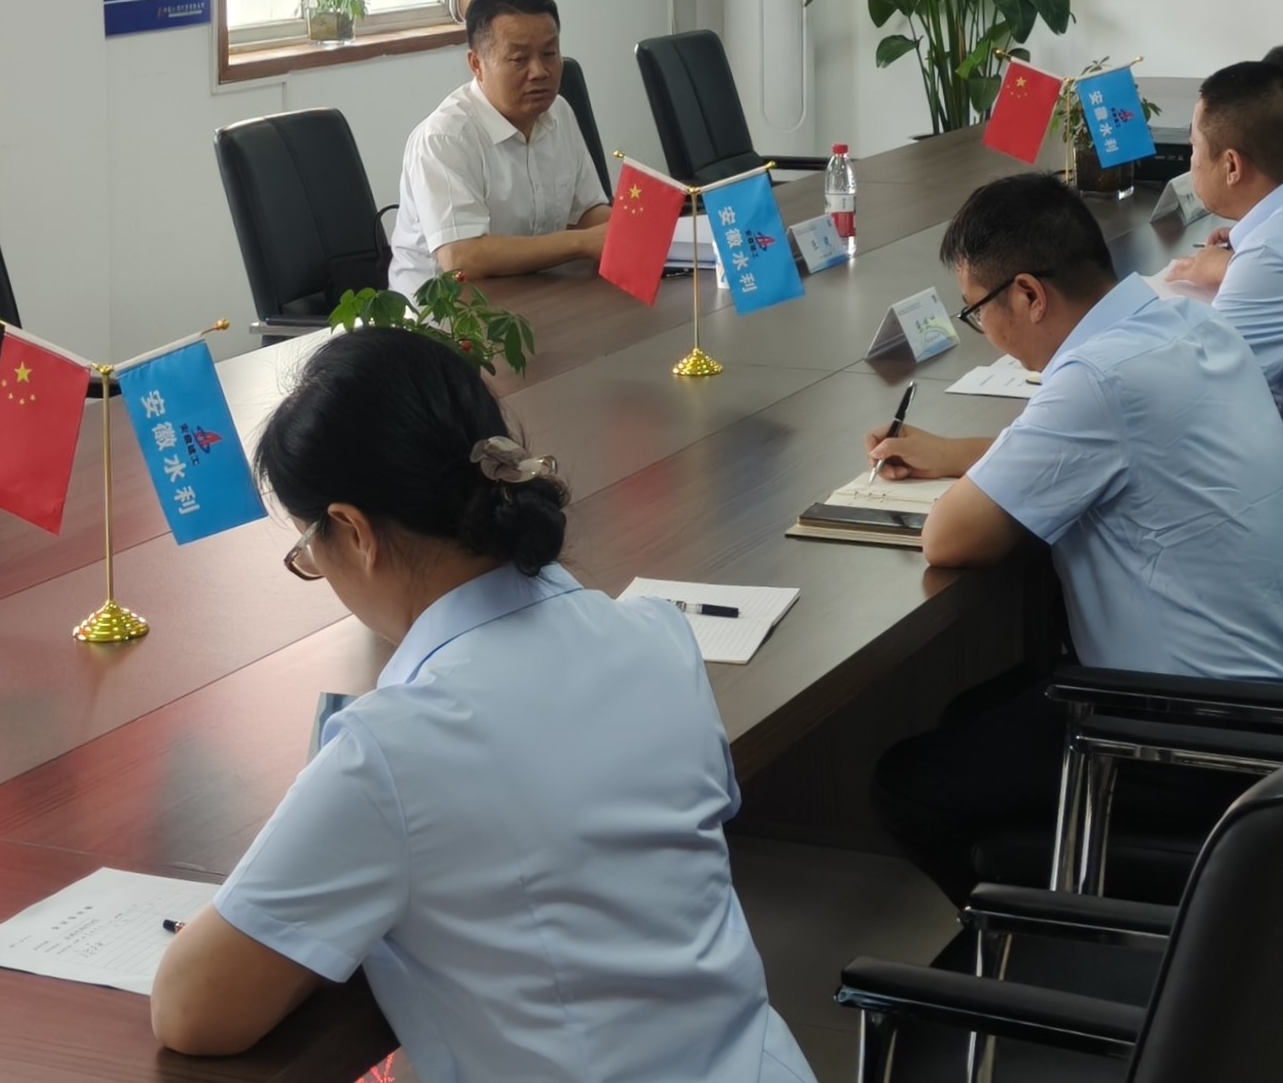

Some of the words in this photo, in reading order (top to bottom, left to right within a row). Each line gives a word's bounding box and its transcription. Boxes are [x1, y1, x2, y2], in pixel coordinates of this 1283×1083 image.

[718, 205, 758, 293] 安徽水利
[141, 389, 200, 515] 安徽水利
